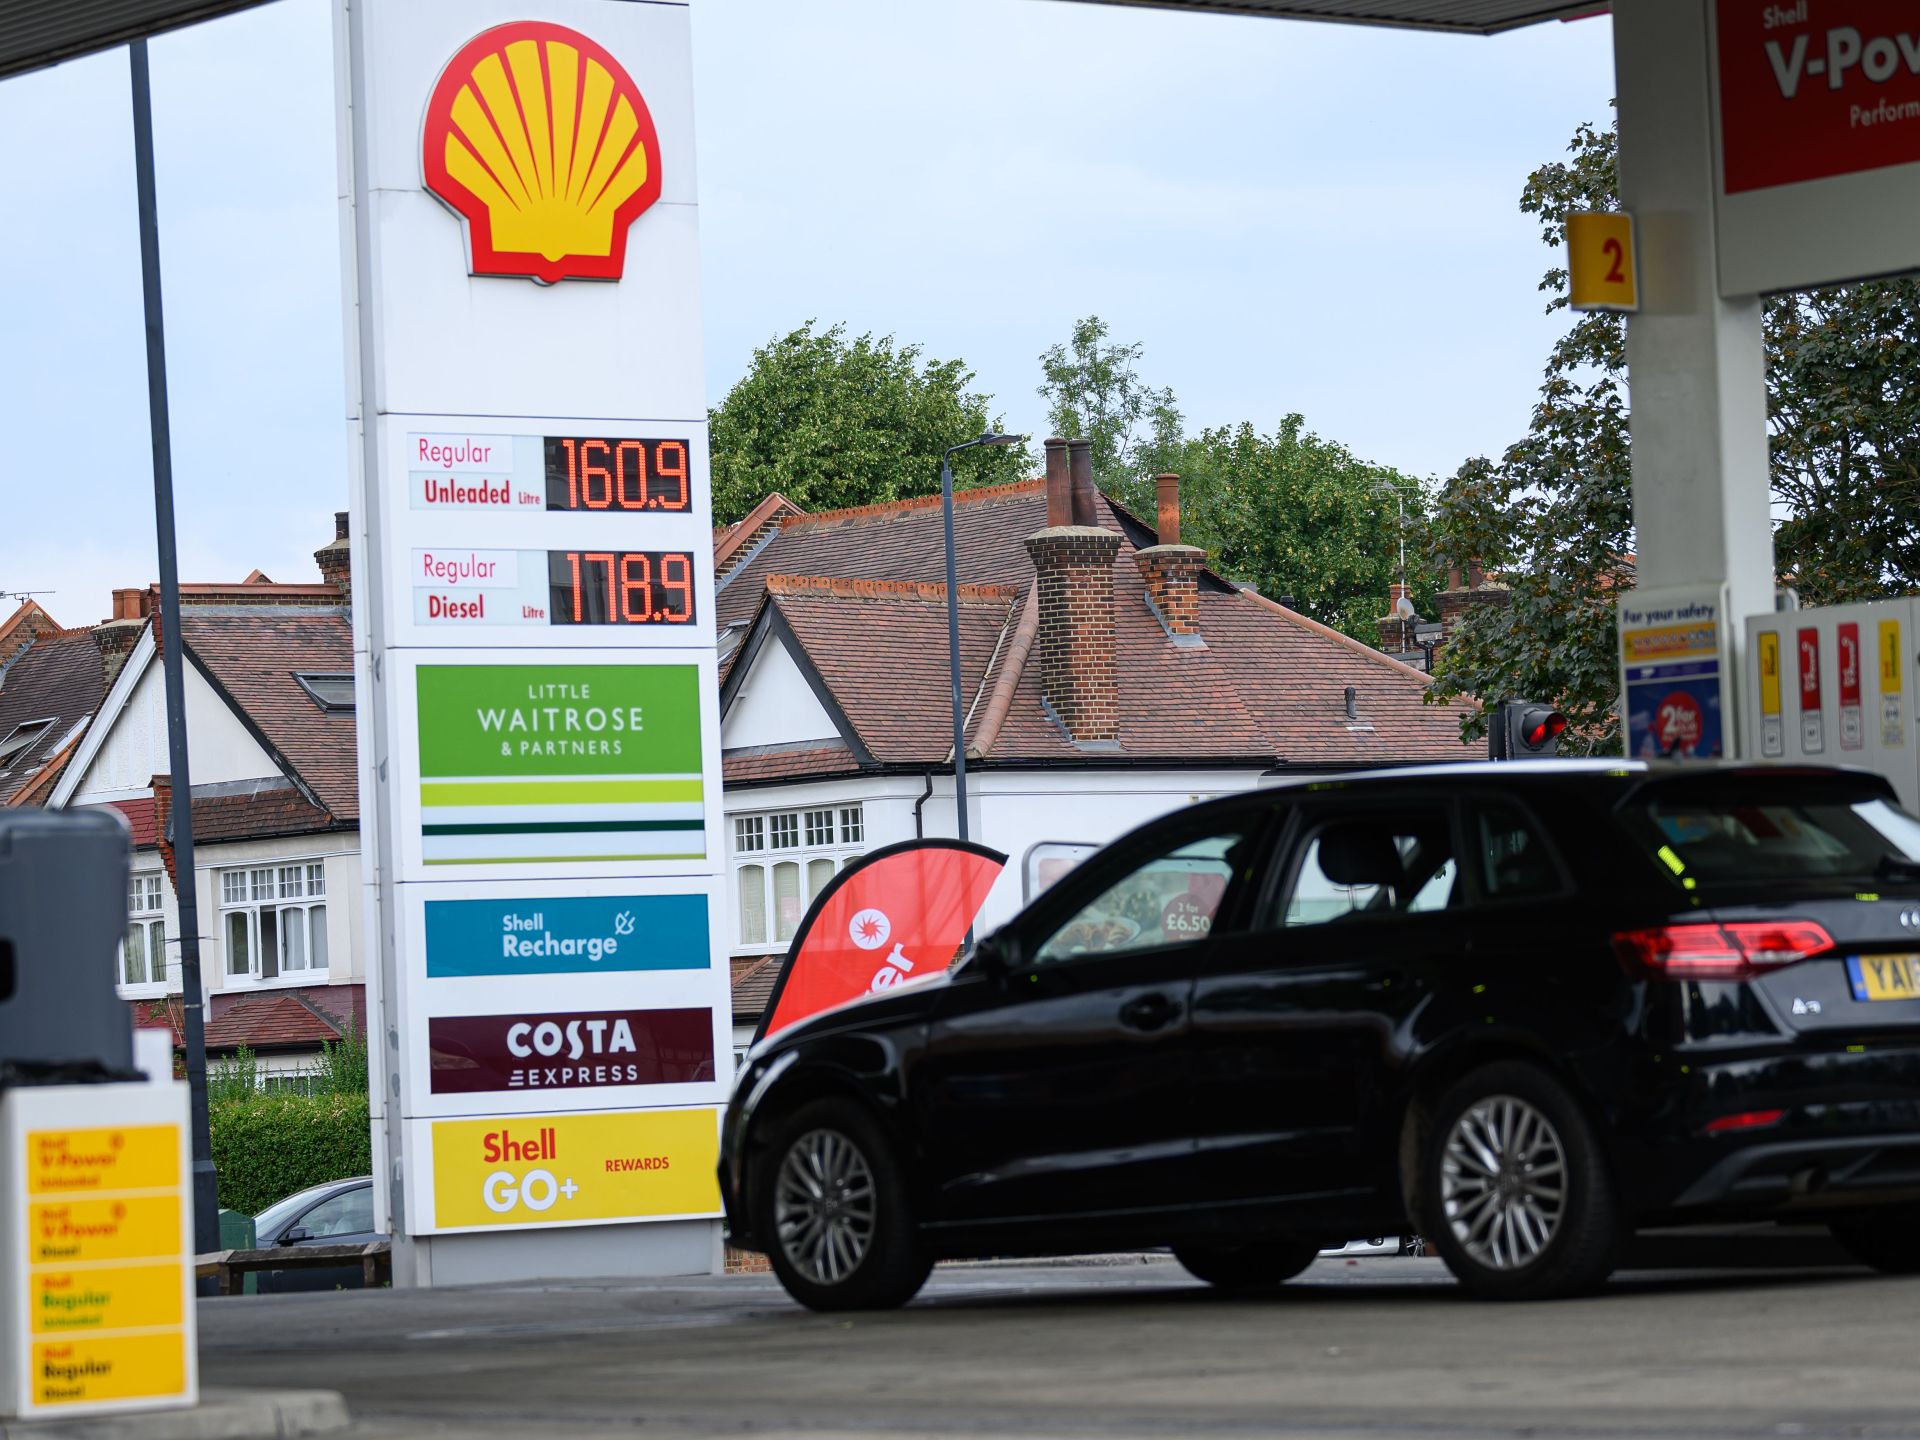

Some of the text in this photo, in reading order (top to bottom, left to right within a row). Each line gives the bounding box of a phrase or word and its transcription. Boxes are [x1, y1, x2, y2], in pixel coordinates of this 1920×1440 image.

[1763, 0, 1808, 29] Shell
[1602, 238, 1625, 284] 2
[419, 438, 491, 468] Regular
[562, 439, 688, 509] 160.9
[425, 479, 541, 505] Unleaded Litre
[424, 553, 496, 584] Regular
[567, 553, 692, 622] 178.9
[429, 594, 545, 619] Diesel Litre
[528, 684, 591, 699] LITTLE
[477, 708, 643, 732] WAITROSE
[501, 740, 623, 756] & PARTNERS
[503, 913, 543, 931] Shell
[1166, 913, 1210, 932] £6.50
[503, 931, 617, 961] Recharge
[506, 1019, 637, 1060] COSTA
[528, 1064, 638, 1086] EXPRESS
[483, 1127, 556, 1163] Shell
[605, 1157, 670, 1172] REWARDS
[482, 1168, 579, 1213] GO+
